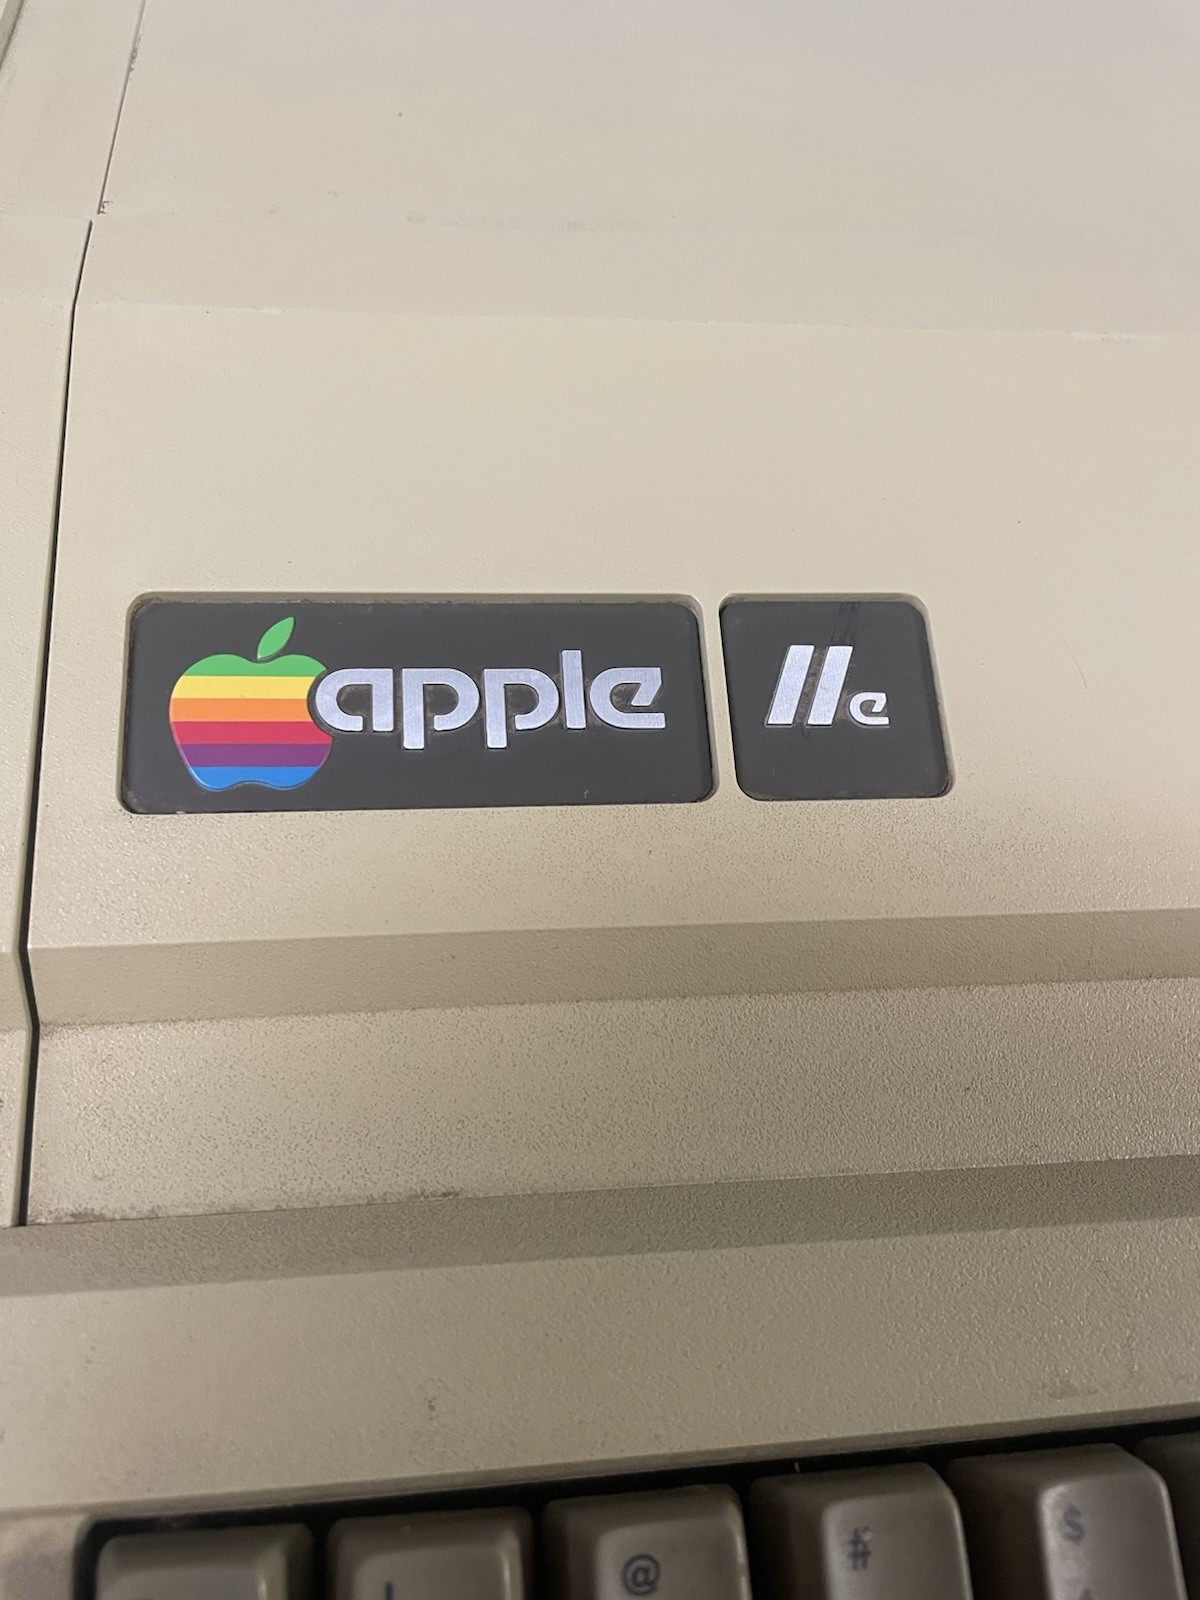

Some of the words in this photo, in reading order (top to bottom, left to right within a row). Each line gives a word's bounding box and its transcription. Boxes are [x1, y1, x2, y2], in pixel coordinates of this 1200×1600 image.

[314, 649, 666, 750] apple
[1063, 1505, 1085, 1545] $
[849, 1526, 871, 1570] #
[622, 1553, 661, 1597] @
